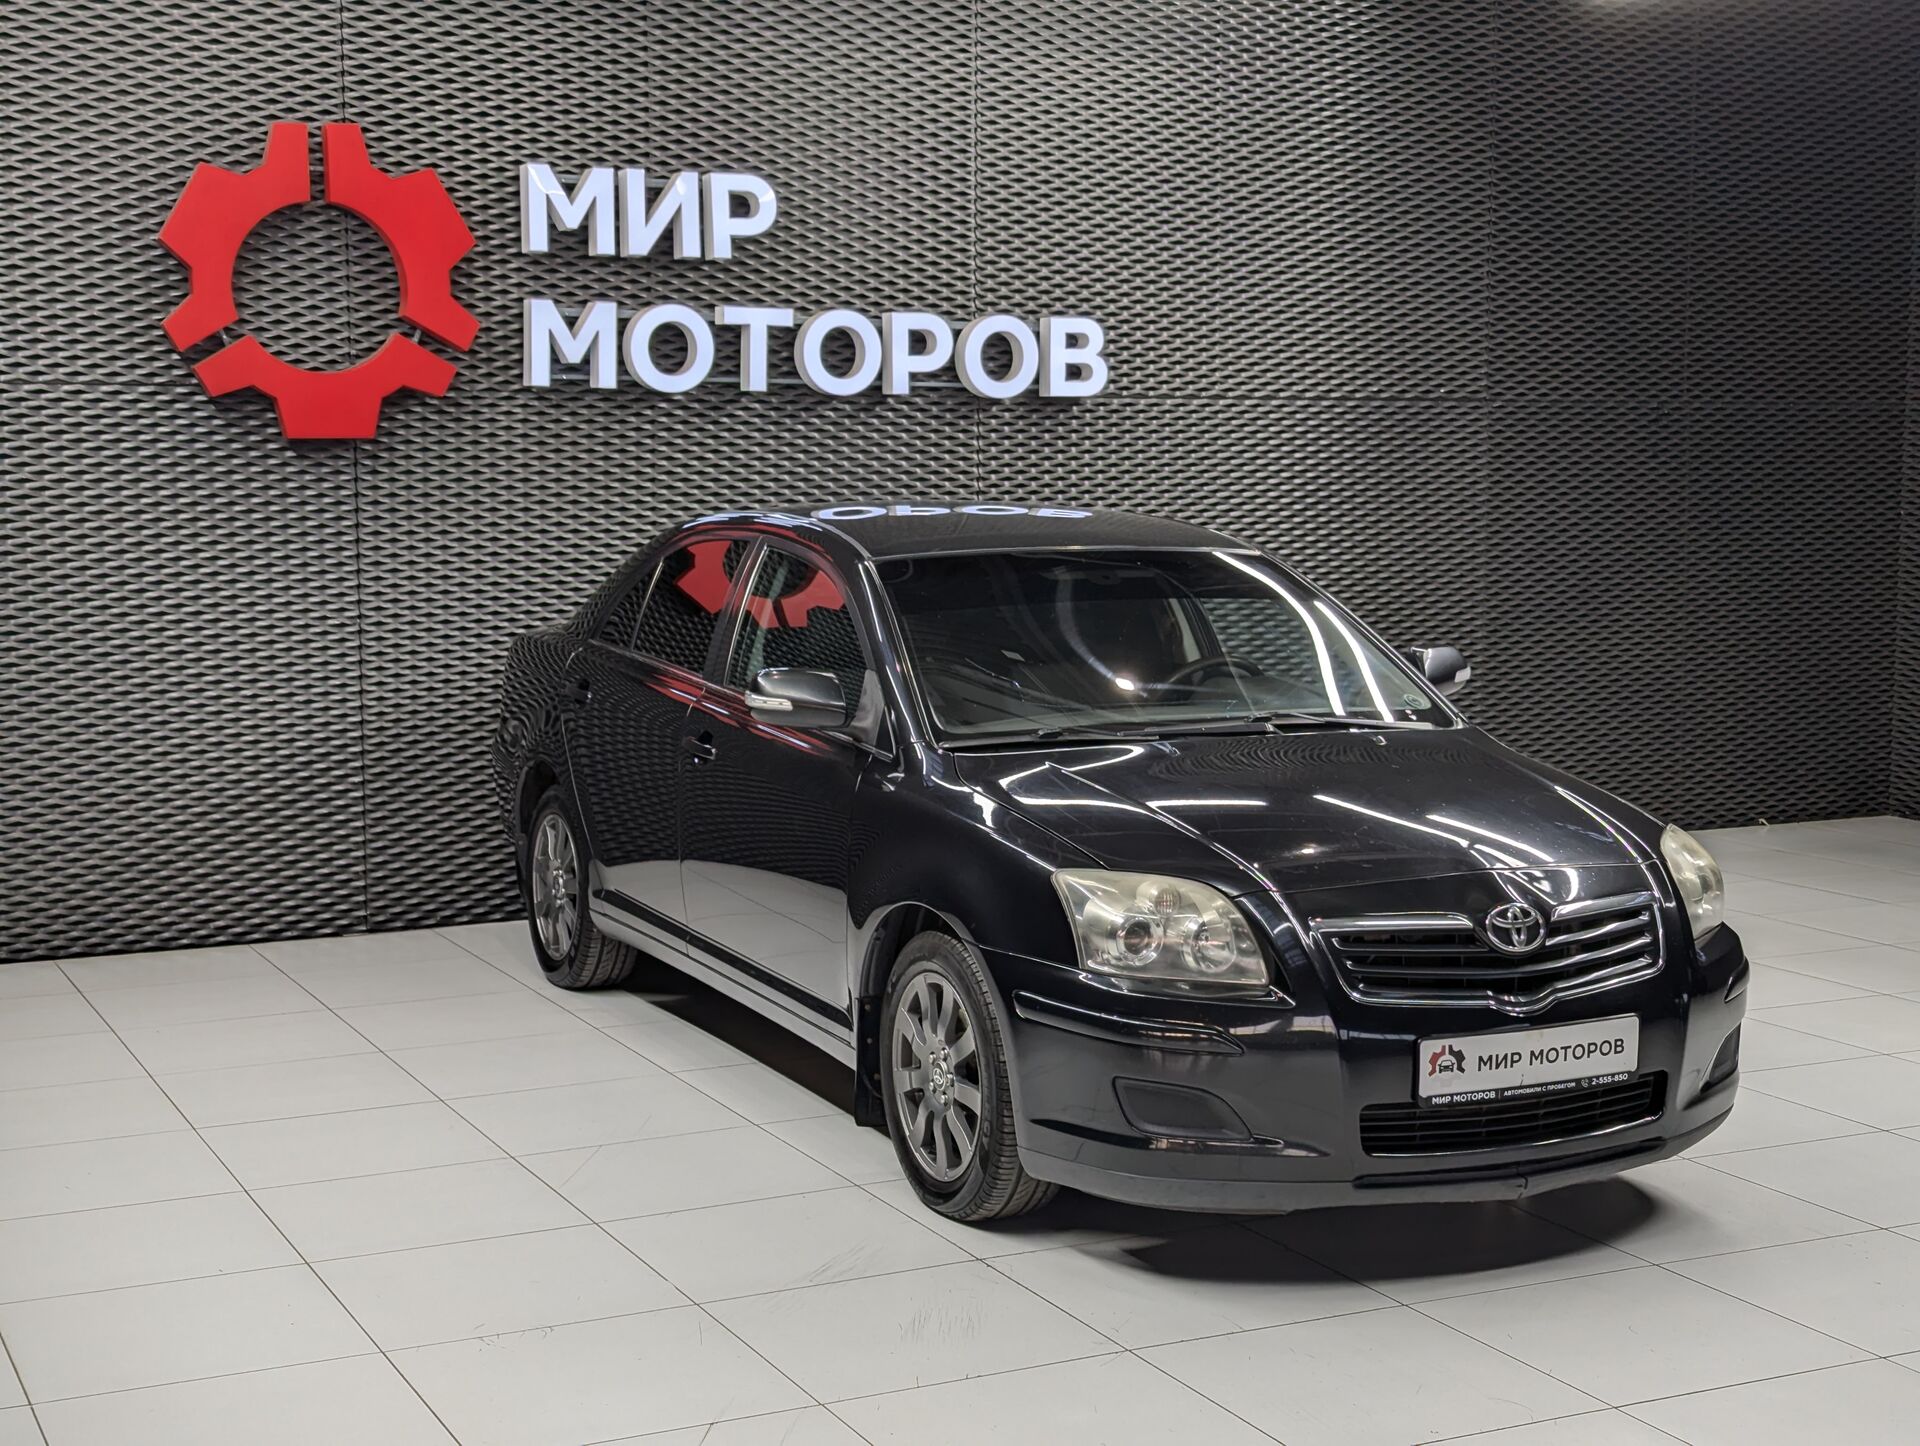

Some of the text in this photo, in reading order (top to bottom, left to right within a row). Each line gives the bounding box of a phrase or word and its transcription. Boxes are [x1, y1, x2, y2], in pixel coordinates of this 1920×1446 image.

[519, 163, 778, 261] МИР
[522, 298, 1109, 399] МОТОРОВ
[1477, 1038, 1625, 1072] МИР МОТОРОВ
[1503, 1086, 1542, 1097] АВТОМОБИЛИ
[1547, 1081, 1576, 1091] ПРОБЕГОМ
[1591, 1072, 1629, 1086] 2-555-850
[1431, 1090, 1496, 1105] МИР МОТОРОВ
